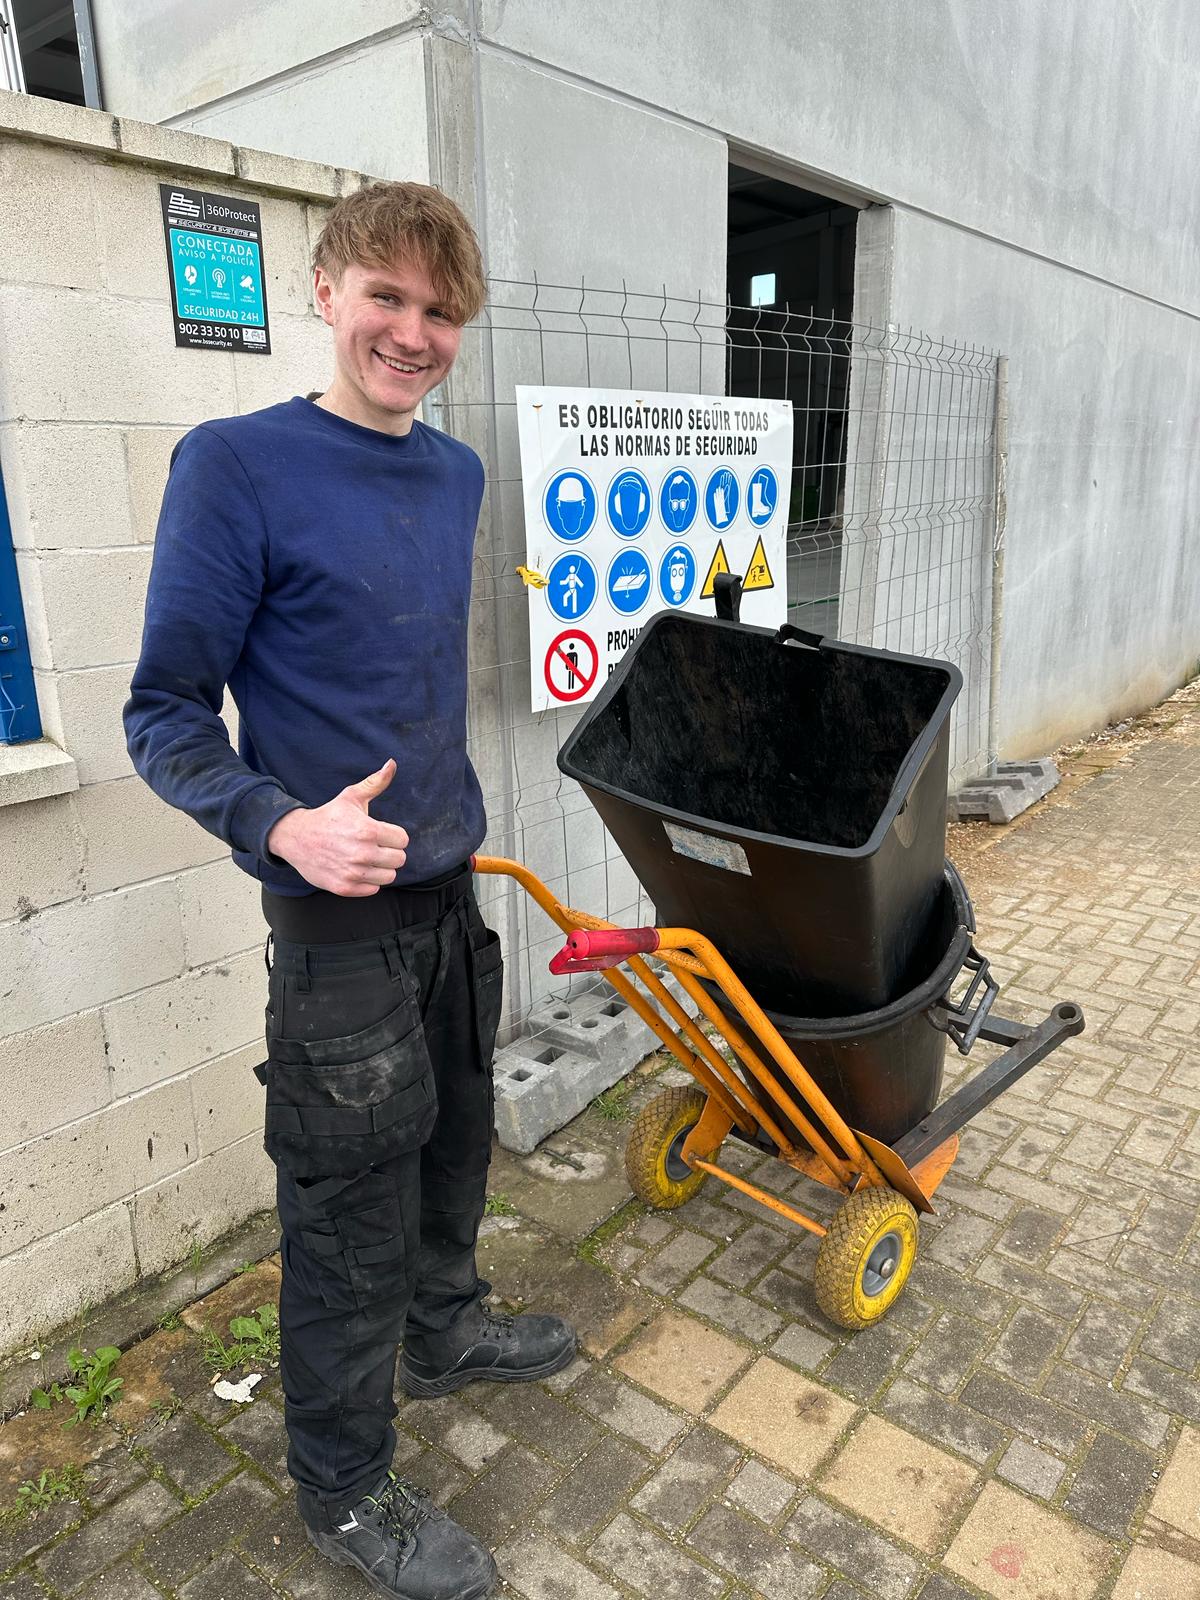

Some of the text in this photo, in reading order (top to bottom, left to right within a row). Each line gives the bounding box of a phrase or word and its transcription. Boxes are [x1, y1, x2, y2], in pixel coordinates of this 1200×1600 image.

[206, 204, 257, 223] 360Protect
[177, 234, 254, 258] CONECTADA
[178, 247, 255, 267] AVISO A POLICÍA
[183, 304, 259, 323] SEGURIDAD 24H
[179, 322, 240, 339] 902 33 50 10
[189, 337, 233, 348] www.bssecurity.es
[558, 404, 769, 432] ES OBLIGATORIO SEGUIR TODAS
[580, 434, 758, 457] LAS NORMAS DE SEGURIDAD
